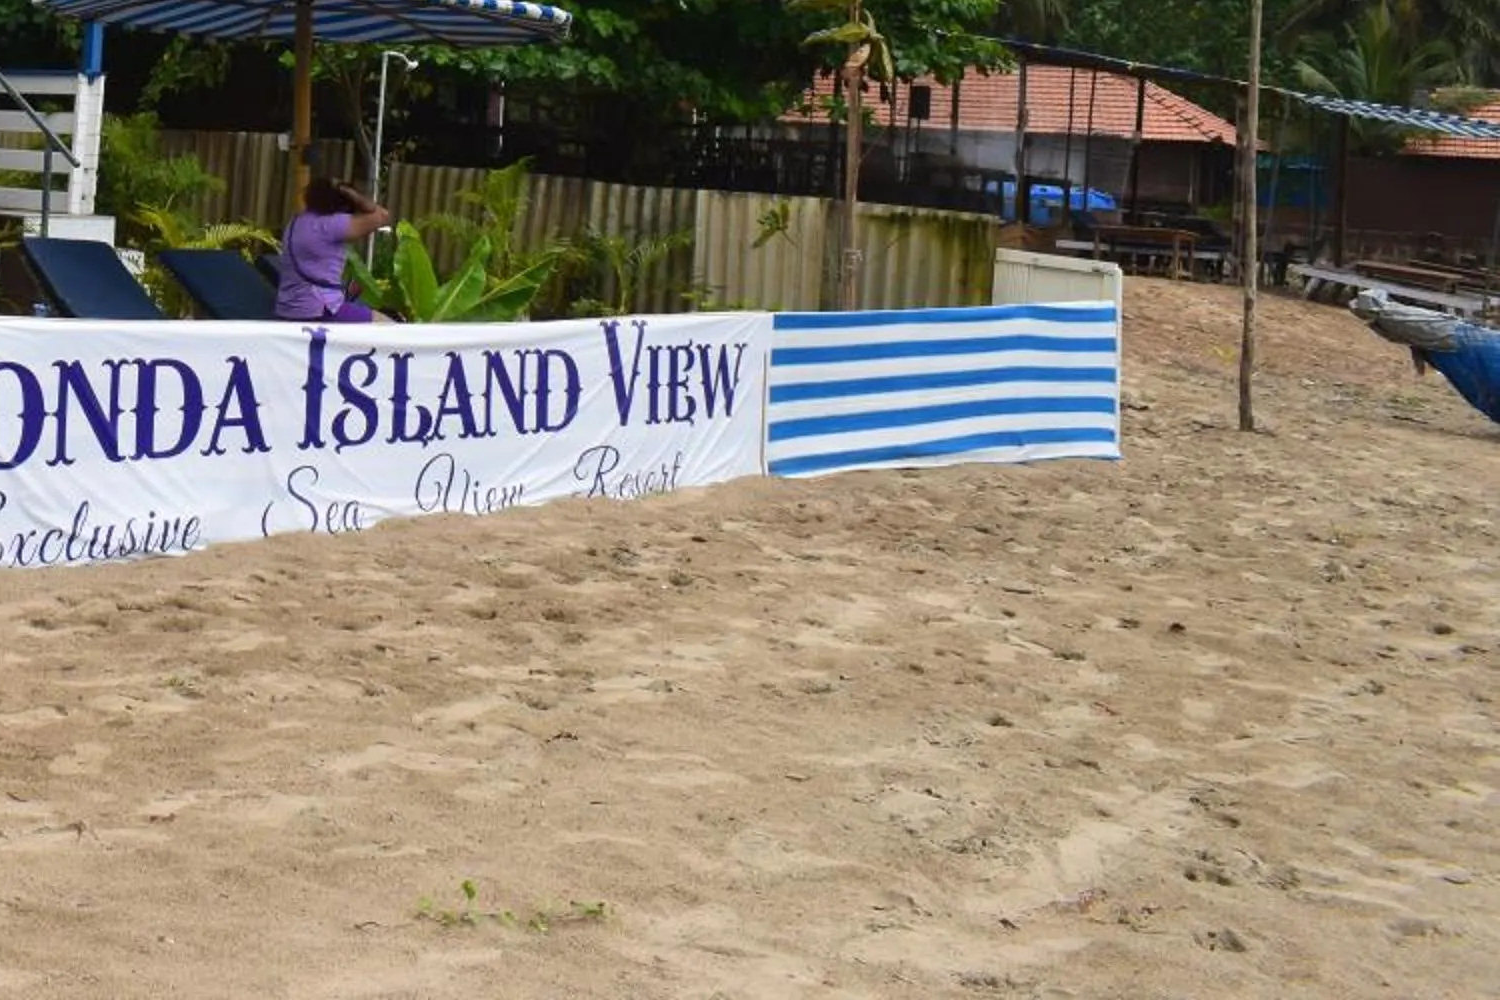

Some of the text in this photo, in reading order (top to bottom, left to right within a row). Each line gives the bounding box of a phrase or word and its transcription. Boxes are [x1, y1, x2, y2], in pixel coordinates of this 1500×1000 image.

[297, 327, 581, 453] ISLAND
[600, 320, 747, 427] VIEW
[261, 465, 364, 537] Sea
